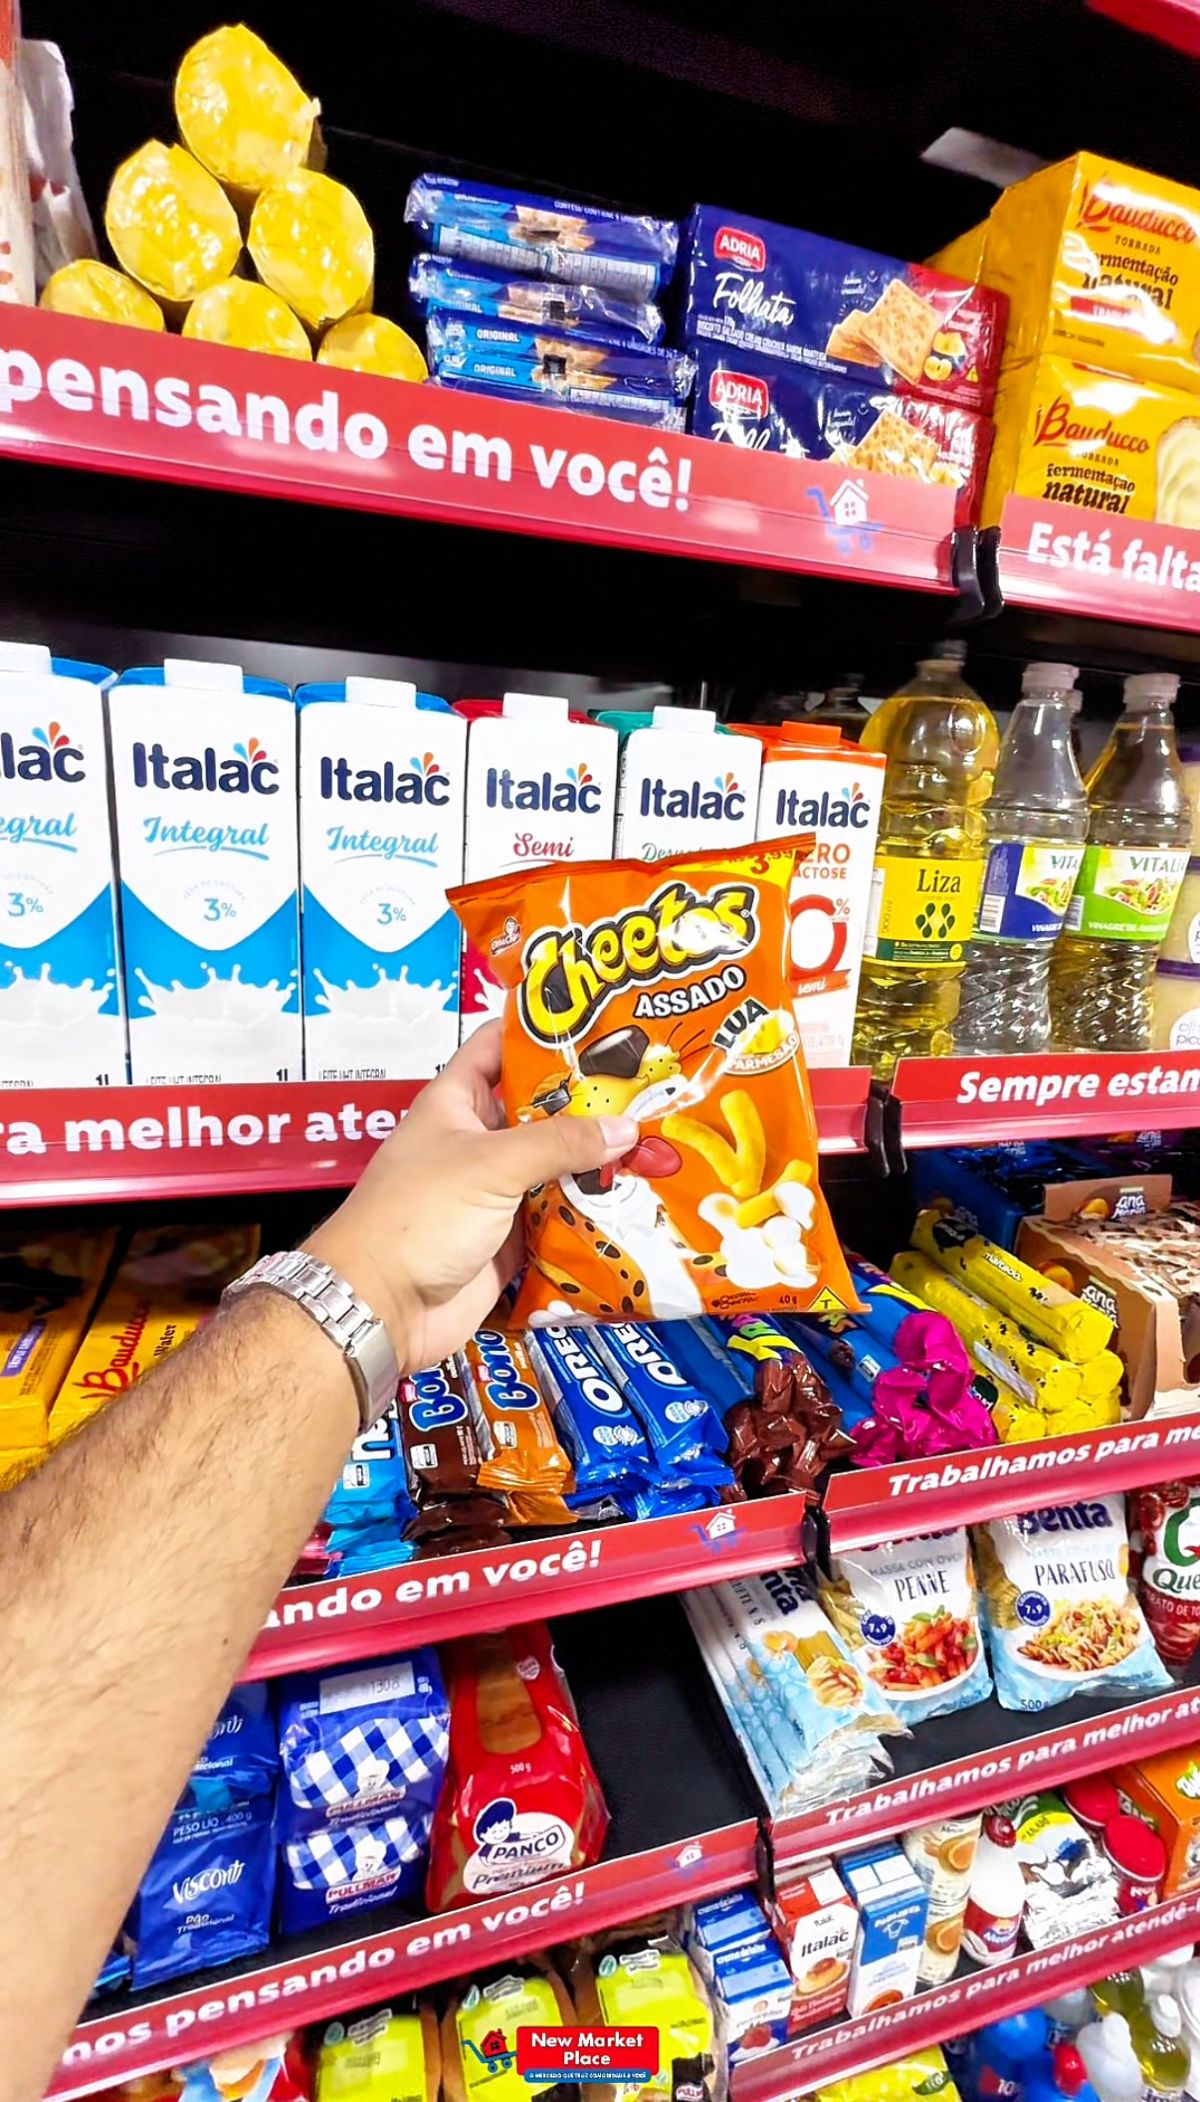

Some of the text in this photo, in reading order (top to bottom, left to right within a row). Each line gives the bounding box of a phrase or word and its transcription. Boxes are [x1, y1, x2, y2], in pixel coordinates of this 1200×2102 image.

[719, 235, 761, 261] ADRIA
[1094, 253, 1179, 286] ermentação
[713, 272, 797, 327] Folhata
[476, 328, 520, 343] ORIGINAL
[473, 364, 517, 377] ORIGINAL
[714, 378, 762, 405] ADRIA
[0, 349, 692, 512] pensando em você!
[1033, 396, 1149, 454] Bauducco
[1042, 480, 1131, 514] natural
[1027, 522, 1111, 577] Está
[0, 731, 86, 784] lac
[133, 740, 280, 796] Italac
[320, 755, 450, 806] Italac
[486, 768, 601, 815] Italac
[640, 778, 746, 821] Italac
[776, 789, 870, 829] Italac
[142, 815, 270, 854] Integral
[326, 825, 439, 862] Integral
[513, 832, 575, 858] Semi
[796, 867, 847, 879] ACTOSE
[916, 868, 961, 893] Liza
[7, 892, 45, 918] 3%
[203, 897, 237, 922] 3%
[376, 902, 408, 926] 3%
[524, 885, 755, 1037] Cheetos
[633, 964, 746, 1020] ASSADO
[714, 998, 769, 1049] LUA
[957, 1071, 1101, 1107] Sempre
[65, 1105, 291, 1152] melhor
[304, 1103, 409, 1143] ate
[1116, 1195, 1146, 1209] ana
[779, 1295, 791, 1305] 40
[820, 1299, 832, 1310] T
[1082, 1284, 1117, 1313] ana
[474, 1330, 541, 1411] Bono
[611, 1323, 689, 1386] ORE
[888, 1441, 1089, 1498] Trabalhamos
[1095, 1429, 1161, 1462] para
[396, 1565, 469, 1604] em
[483, 1540, 601, 1588] você!
[868, 1561, 907, 1577] MASSA
[1034, 1558, 1115, 1587] PARAFUSO
[895, 1570, 951, 1602] PENNE
[1176, 1604, 1189, 1616] DE
[1020, 1698, 1042, 1711] 500
[509, 1762, 525, 1774] 500
[826, 1754, 1011, 1828] Trabalhamos
[1015, 1736, 1077, 1773] para
[1082, 1707, 1173, 1747] melhor
[328, 1790, 402, 1818] PULLMAN
[173, 1819, 201, 1838] PESO
[492, 1831, 560, 1860] PANCO
[172, 1858, 247, 1905] Visconti
[327, 1872, 397, 1901] PULLMAN
[472, 1861, 566, 1890] Premium
[165, 1946, 395, 2038] pensando
[406, 1925, 471, 1961] em
[481, 1881, 587, 1935] você!
[800, 1930, 850, 1958] Italac
[791, 1985, 961, 2061] Trabalhamos
[965, 1965, 1021, 2001] para
[1026, 1932, 1109, 1974] melhor
